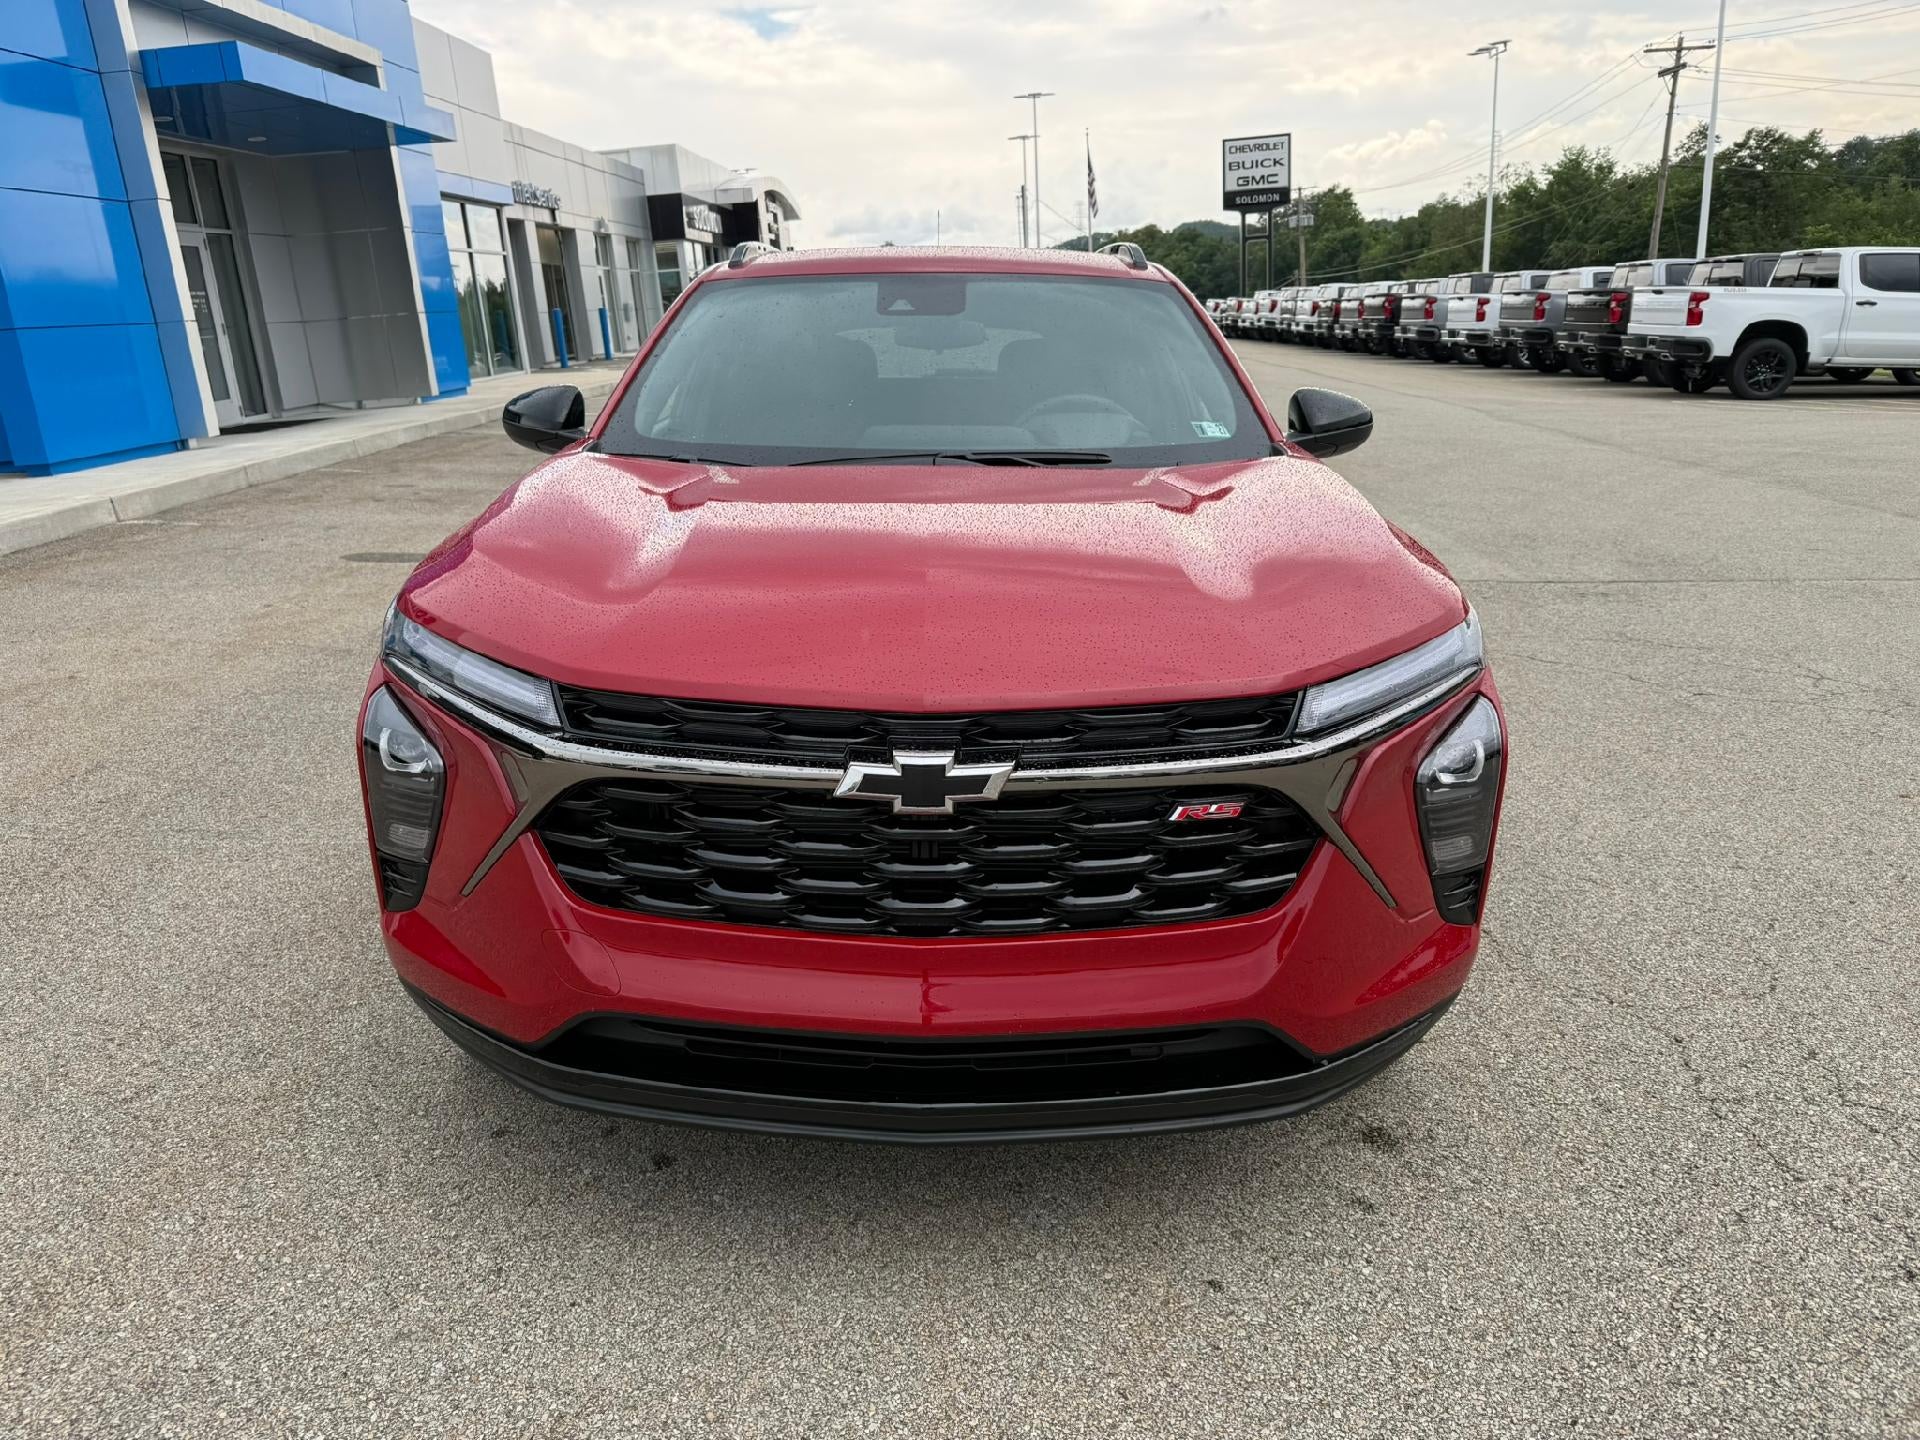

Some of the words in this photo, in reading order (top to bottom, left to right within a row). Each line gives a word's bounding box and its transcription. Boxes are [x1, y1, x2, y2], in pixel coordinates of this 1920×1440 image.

[1228, 142, 1285, 154] CHEVROLET
[1228, 158, 1285, 171] BUICK
[1236, 173, 1279, 187] GMC
[1235, 193, 1280, 204] SOLOMON
[1168, 802, 1245, 820] RS
